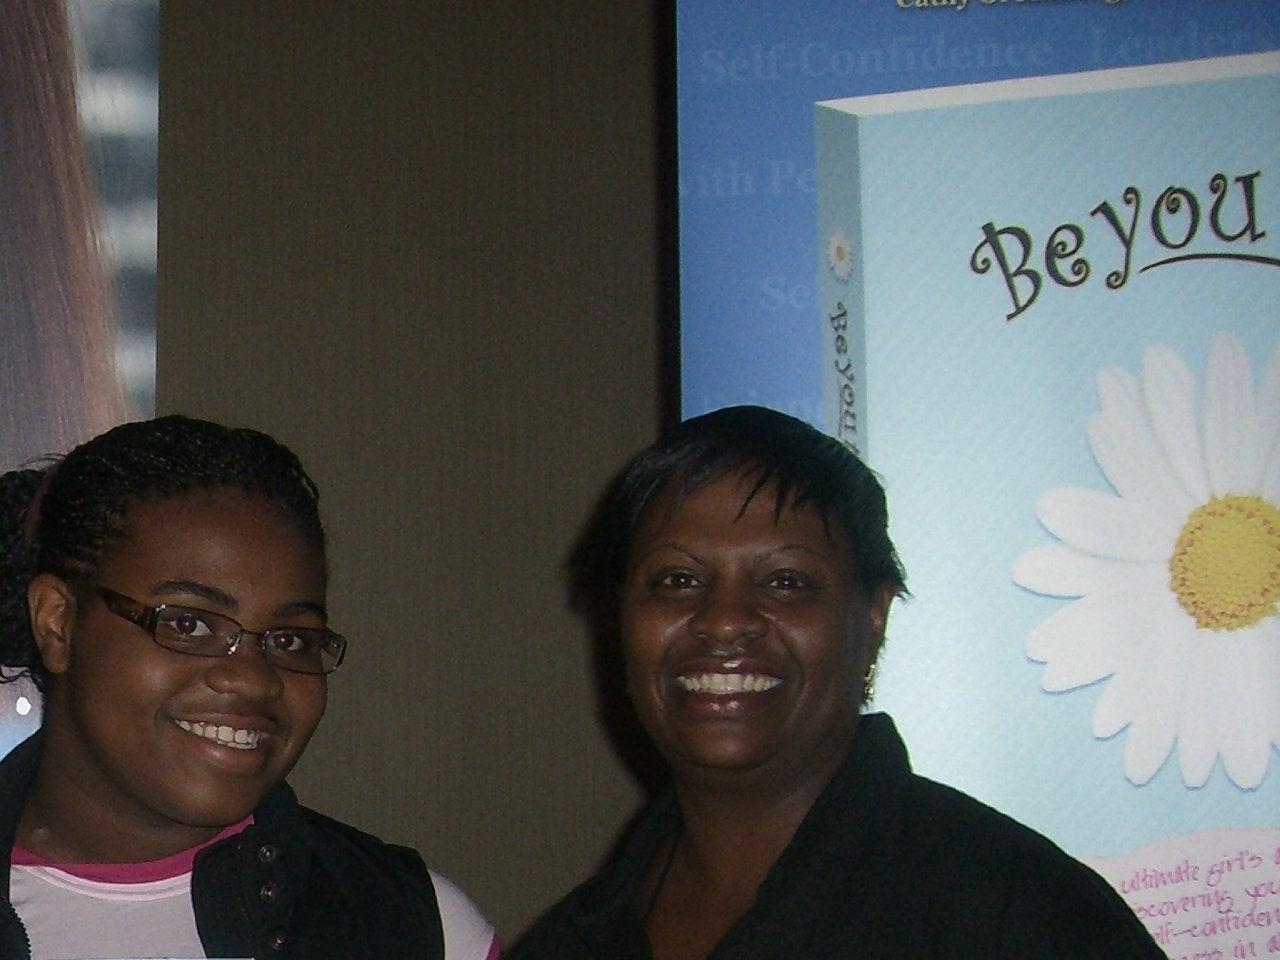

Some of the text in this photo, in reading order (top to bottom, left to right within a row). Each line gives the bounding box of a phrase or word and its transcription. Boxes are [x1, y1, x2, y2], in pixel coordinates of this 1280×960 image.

[1121, 860, 1200, 894] ultimate
[1207, 850, 1263, 887] girl's
[1134, 889, 1234, 919] scovering
[1233, 939, 1257, 959] in
